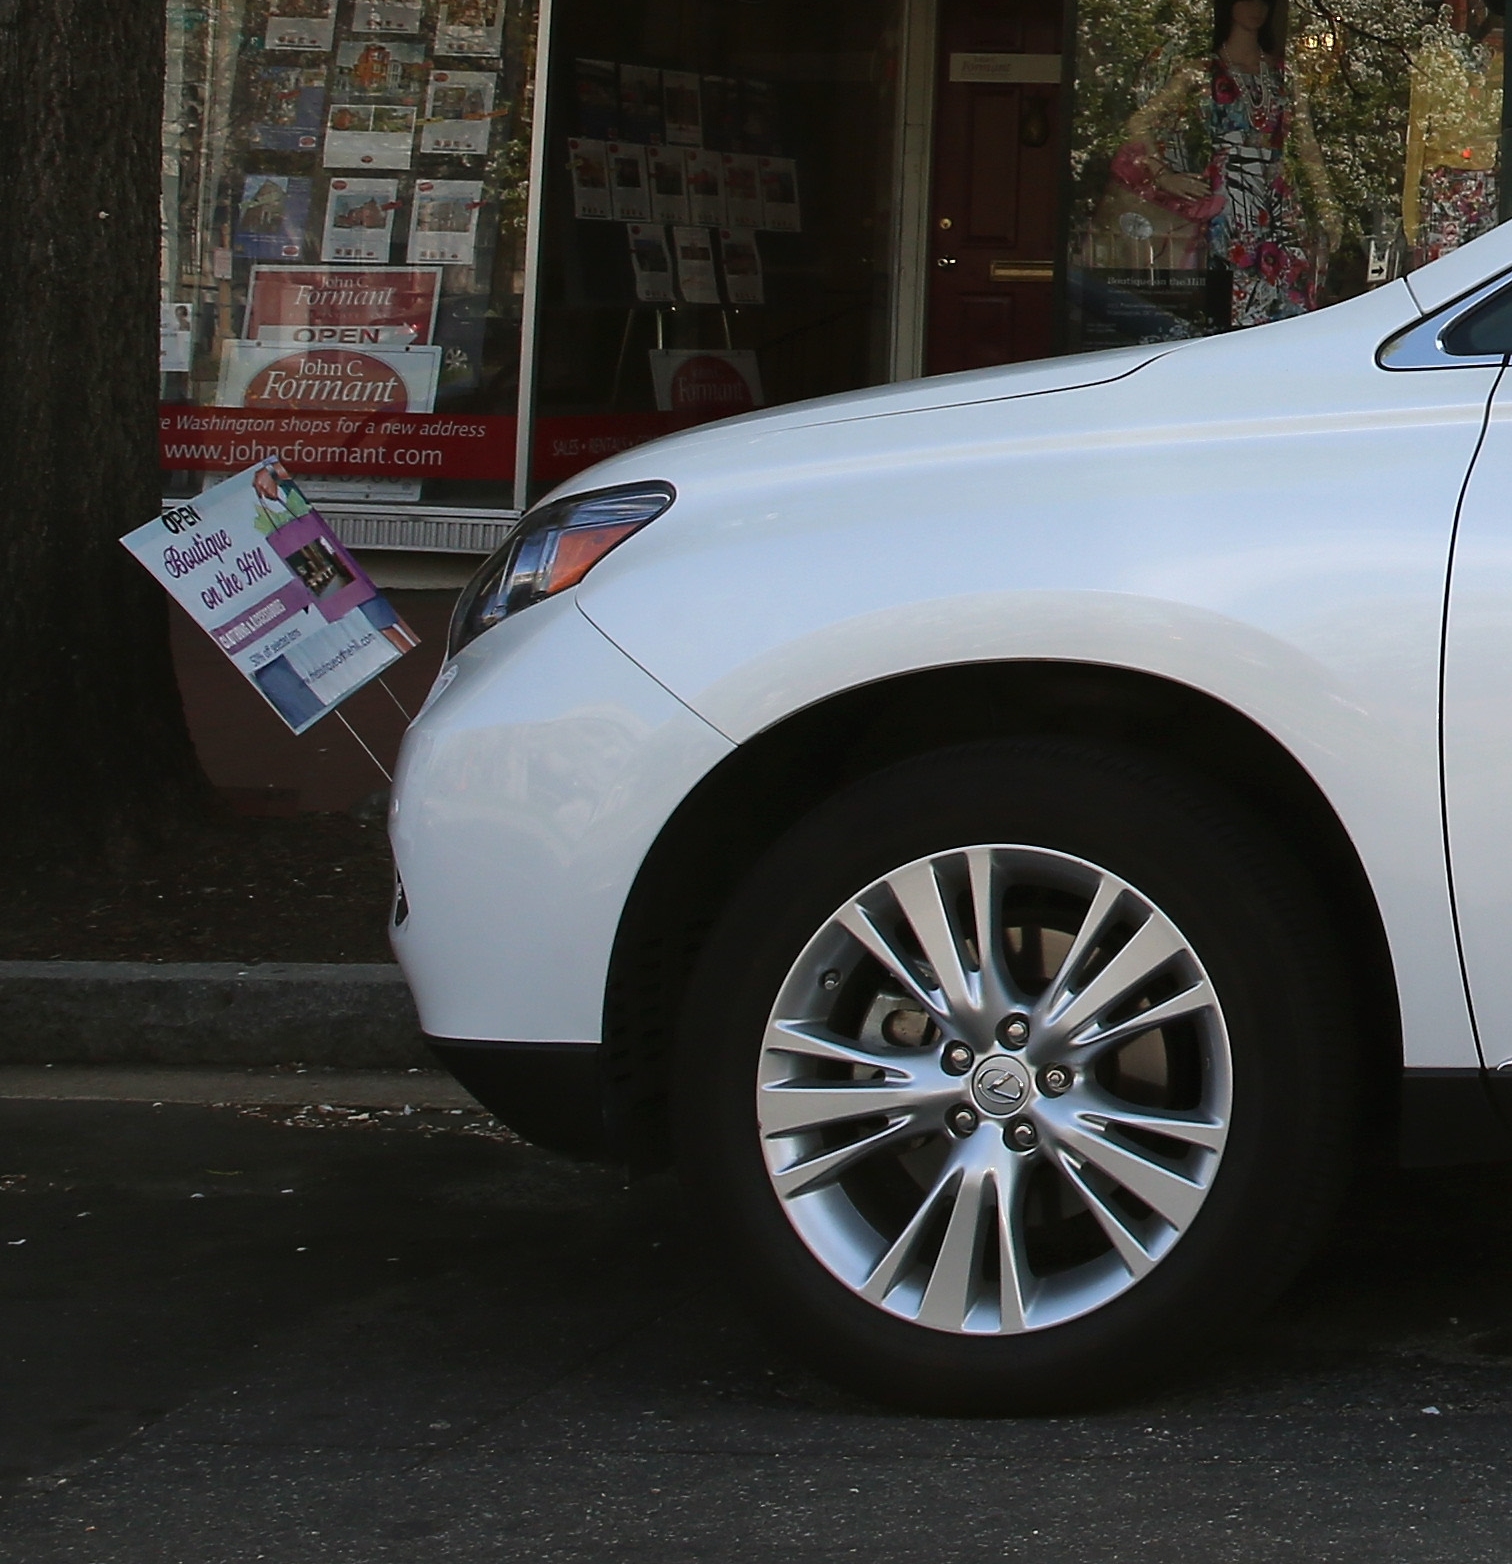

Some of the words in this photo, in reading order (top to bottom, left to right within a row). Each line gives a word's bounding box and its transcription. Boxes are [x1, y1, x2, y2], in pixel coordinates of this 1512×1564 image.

[294, 286, 394, 308] Formant
[293, 329, 379, 344] OPEN
[295, 359, 340, 378] John
[260, 371, 397, 403] Formant
[176, 415, 275, 435] Washington
[279, 418, 331, 435] shops
[336, 417, 360, 434] for
[365, 423, 374, 433] a
[381, 422, 415, 435] new
[419, 420, 486, 438] address
[164, 439, 443, 465] www.johncformant.com
[160, 504, 202, 535] OPEN
[163, 528, 232, 579] Boutique
[200, 590, 222, 610] on
[221, 571, 244, 599] the
[236, 546, 273, 586] Hill
